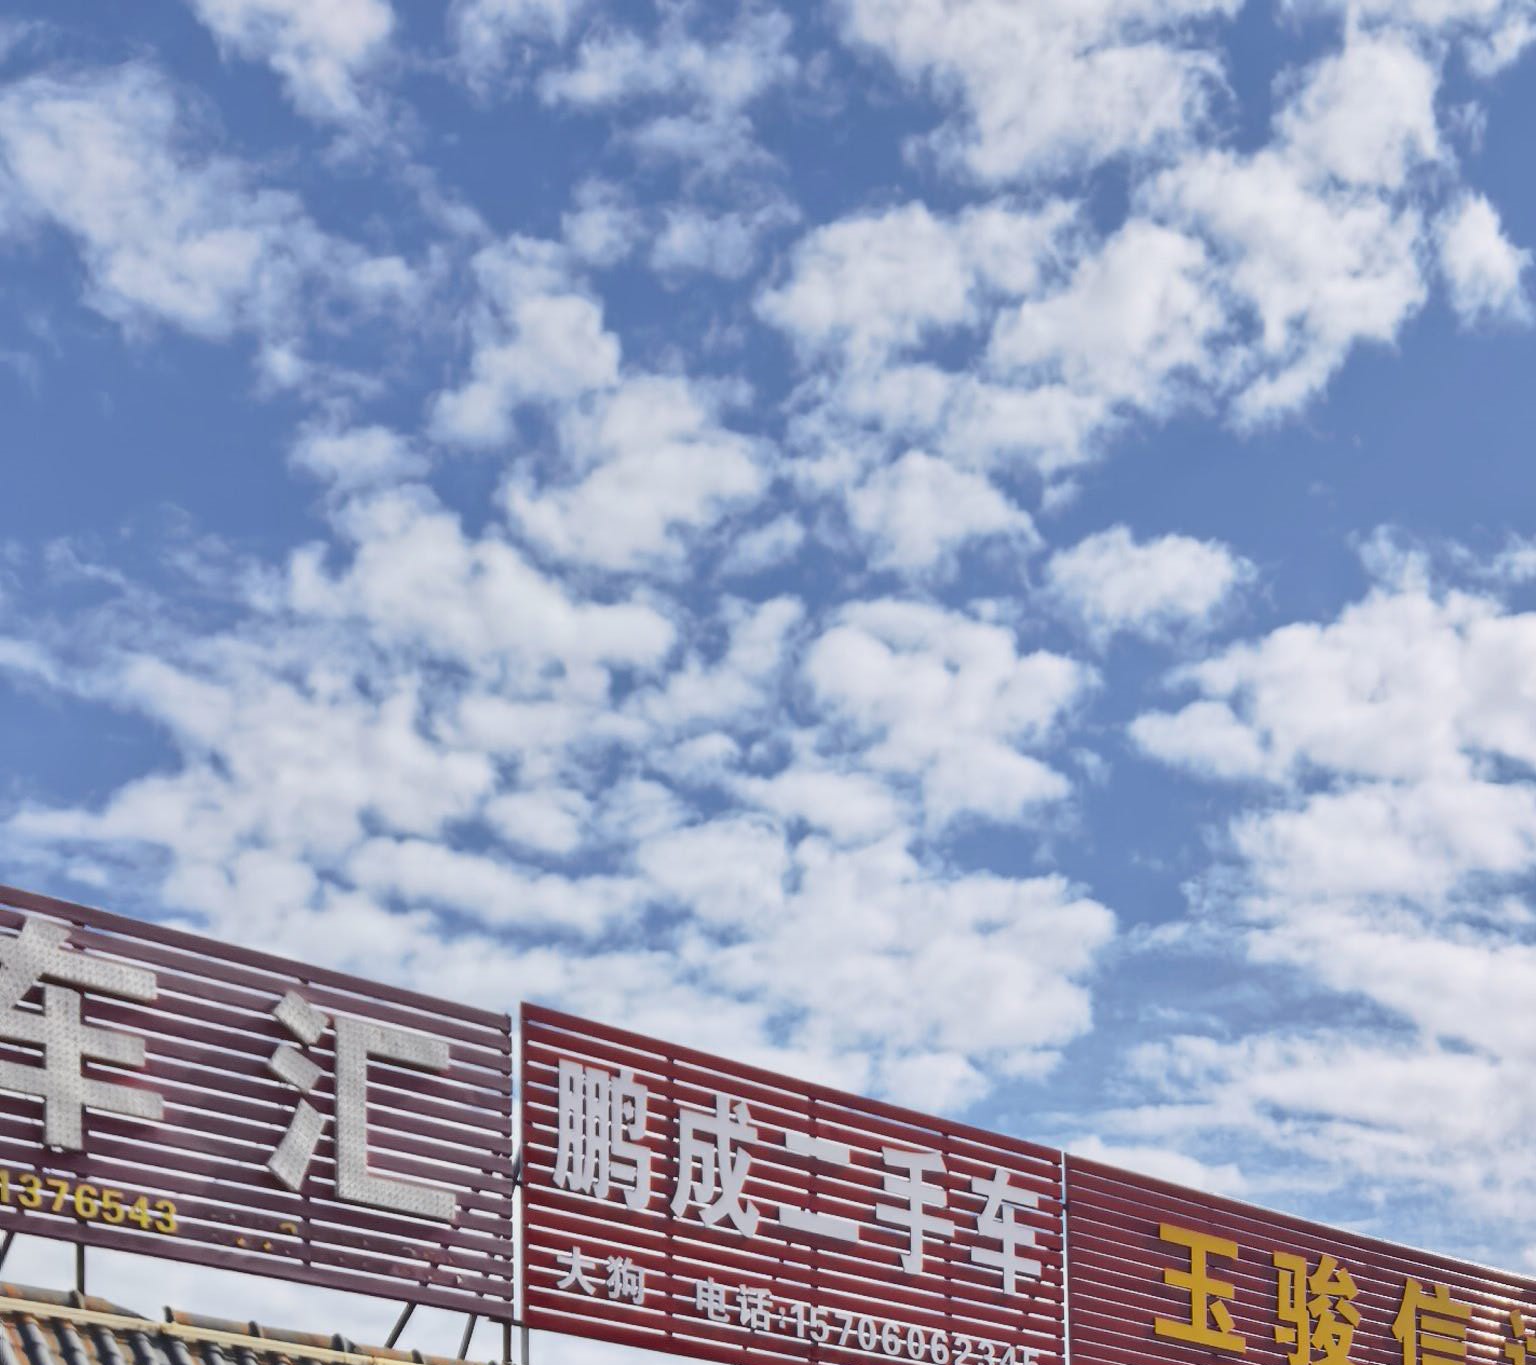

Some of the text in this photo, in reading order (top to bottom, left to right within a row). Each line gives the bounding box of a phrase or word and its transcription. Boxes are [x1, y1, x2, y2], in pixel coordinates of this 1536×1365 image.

[553, 1056, 1043, 1296] 鹏成二手车
[556, 1245, 647, 1306] 大狗
